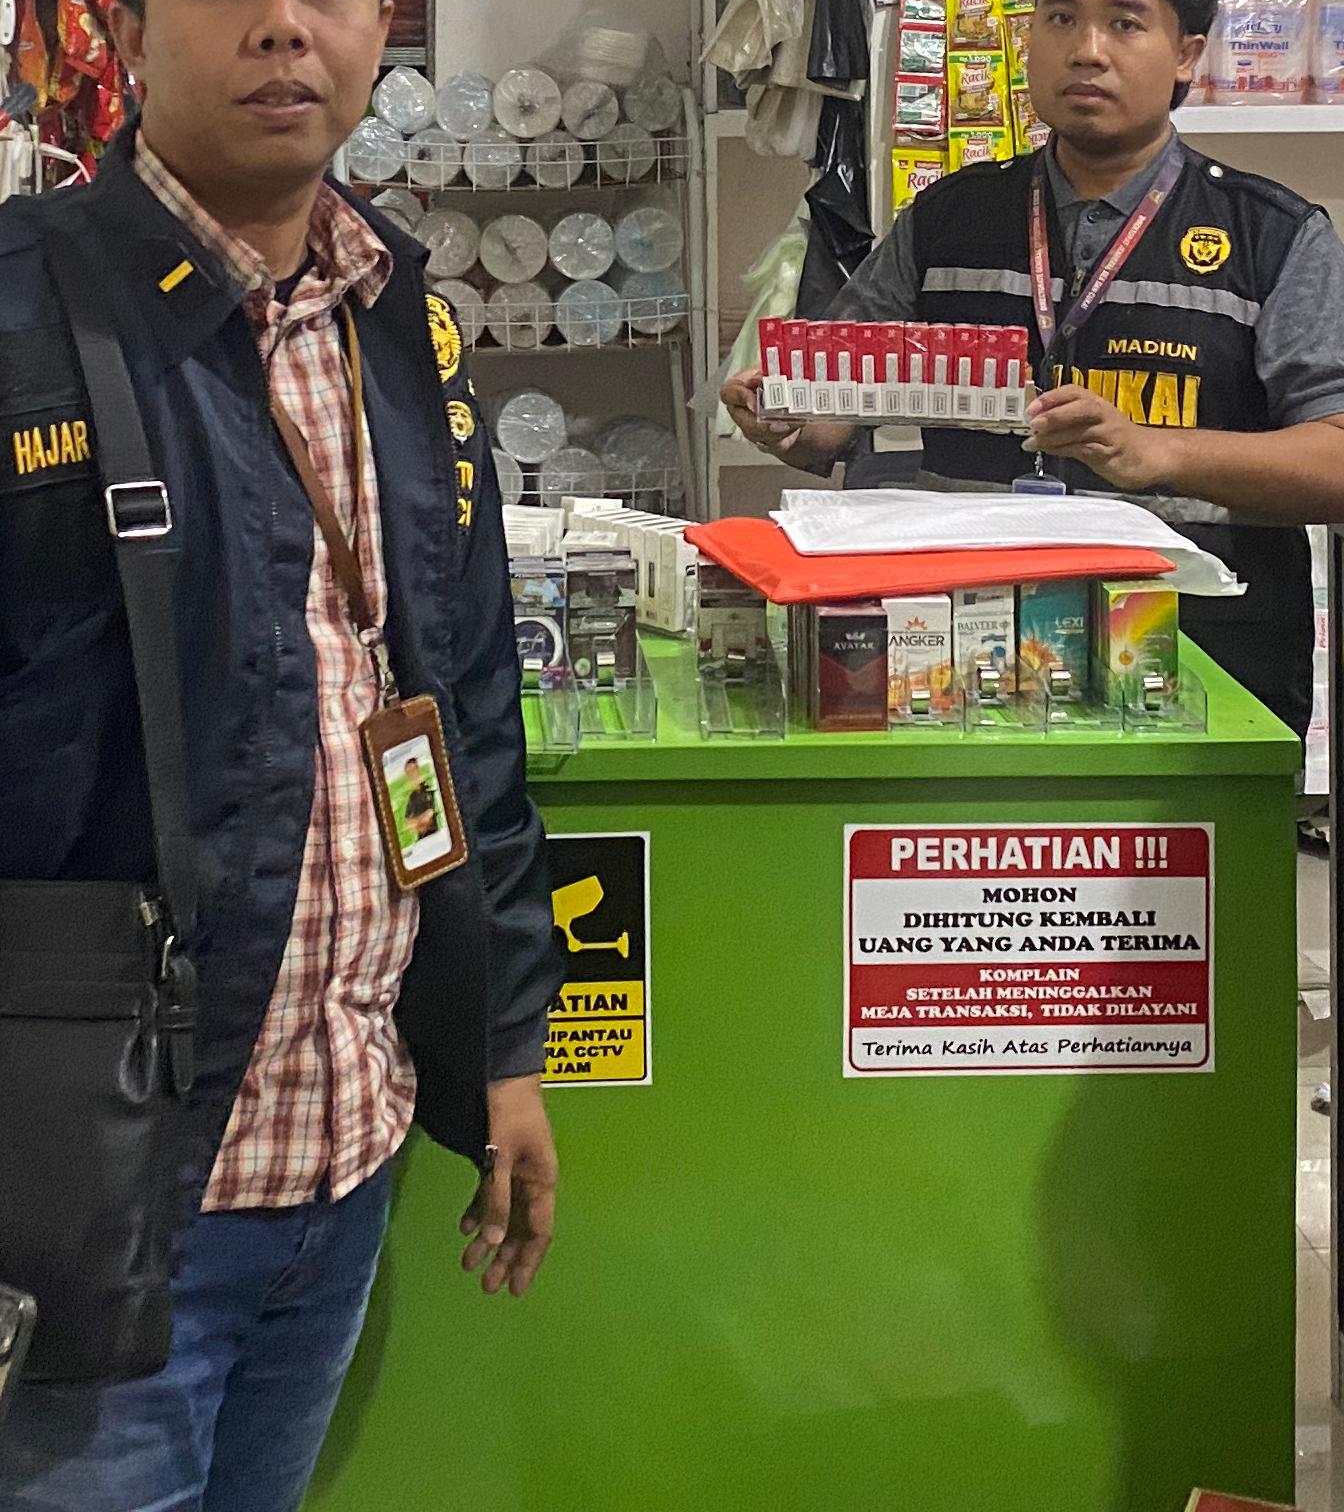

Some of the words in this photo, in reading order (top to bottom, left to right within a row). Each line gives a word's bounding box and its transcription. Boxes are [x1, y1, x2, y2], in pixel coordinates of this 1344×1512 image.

[1229, 41, 1289, 50] ThinWall
[961, 72, 991, 85] Racik
[962, 147, 991, 159] Racik
[908, 171, 944, 190] Raci
[1107, 339, 1198, 361] MADIUN
[1071, 365, 1201, 428] UKAI
[13, 420, 91, 475] HAJAR
[889, 635, 945, 647] ANGKER
[891, 836, 1120, 871] PERHATIAN
[1135, 836, 1168, 870] !!!
[982, 887, 1077, 904] MOHON
[903, 912, 1033, 929] DIHITUNG
[1039, 910, 1156, 927] KEMBALI
[858, 937, 933, 953] UANG
[940, 936, 1012, 952] YANG
[1019, 935, 1094, 952] ANDA
[1100, 934, 1200, 951] TERIMA
[979, 968, 1080, 982] KOMPLAIN
[906, 987, 993, 1001] SETELAH
[996, 985, 1153, 1000] MENINGGALKAN
[549, 994, 628, 1012] ATIAN
[860, 1005, 913, 1019] MEJA
[916, 1004, 1033, 1019] TRANSAKSI,
[1040, 1003, 1102, 1017] TIDAK
[1105, 1002, 1198, 1016] DILAYANI
[544, 1029, 632, 1043] IPANTAU
[574, 1045, 624, 1058] CCTV
[862, 1040, 933, 1056] Terima
[942, 1038, 994, 1055] Kasih
[1002, 1039, 1048, 1054] Atas
[1057, 1036, 1192, 1057] Perhatiannya
[553, 1062, 591, 1074] JAM
